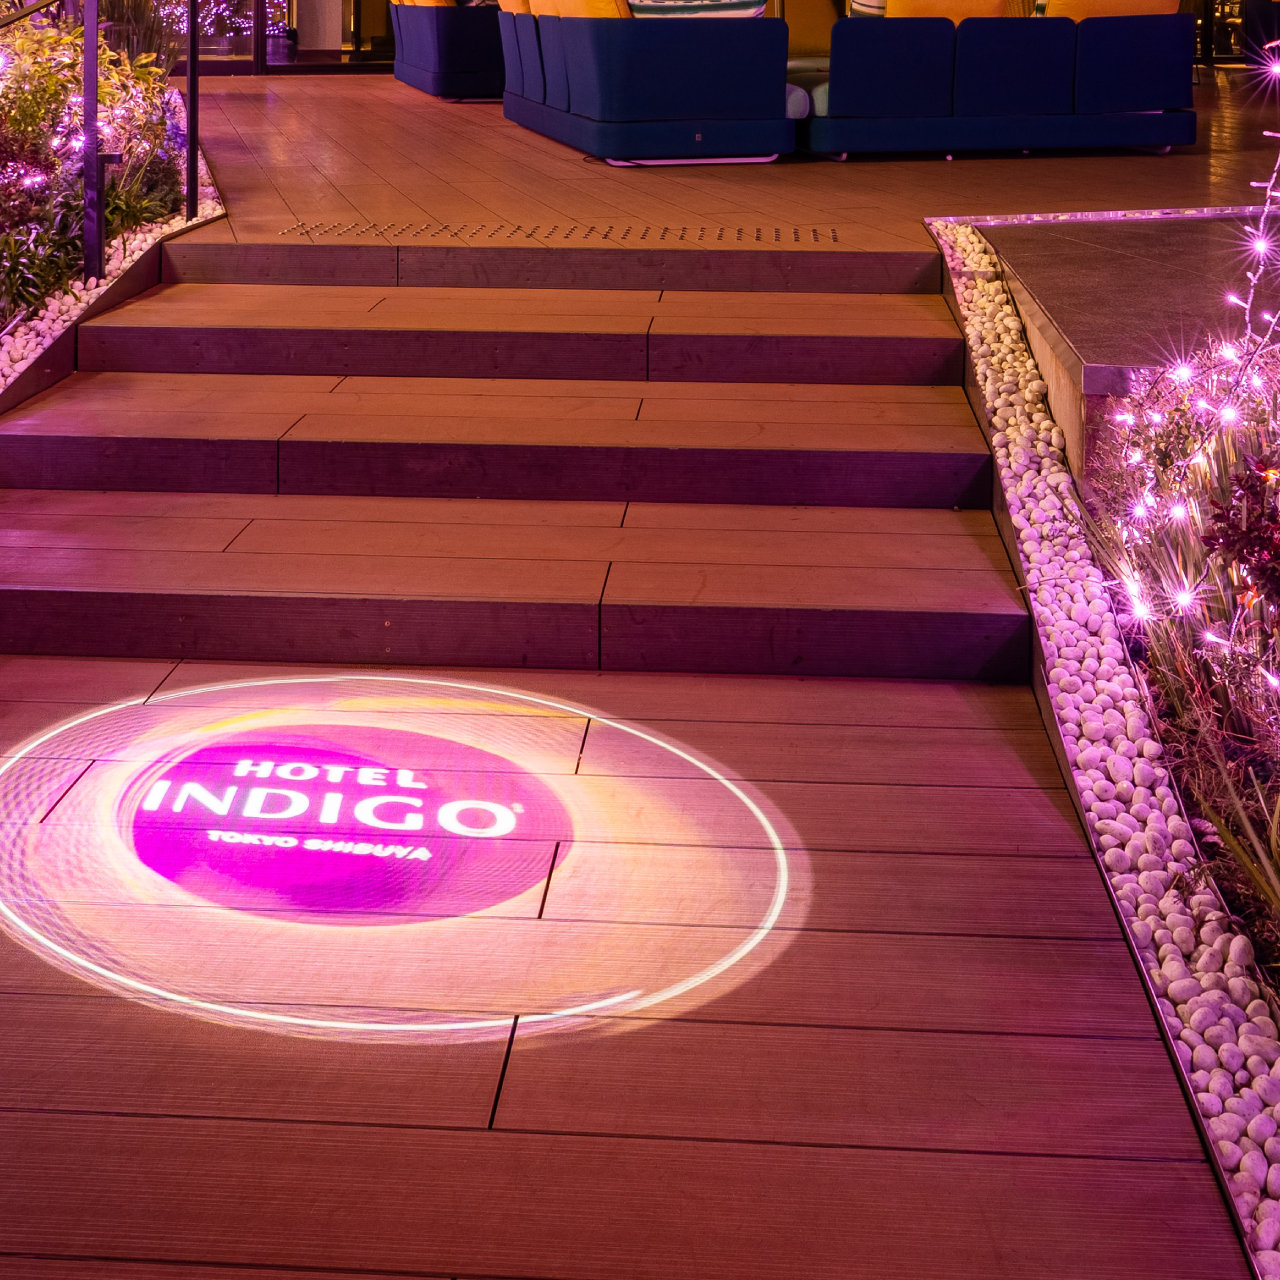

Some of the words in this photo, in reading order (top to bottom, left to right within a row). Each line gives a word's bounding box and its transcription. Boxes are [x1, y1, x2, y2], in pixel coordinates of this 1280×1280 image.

[233, 759, 428, 789] HOTEL
[142, 779, 517, 838] INDIGO
[206, 829, 299, 848] TOKYO
[303, 838, 433, 861] SHIBUYA
